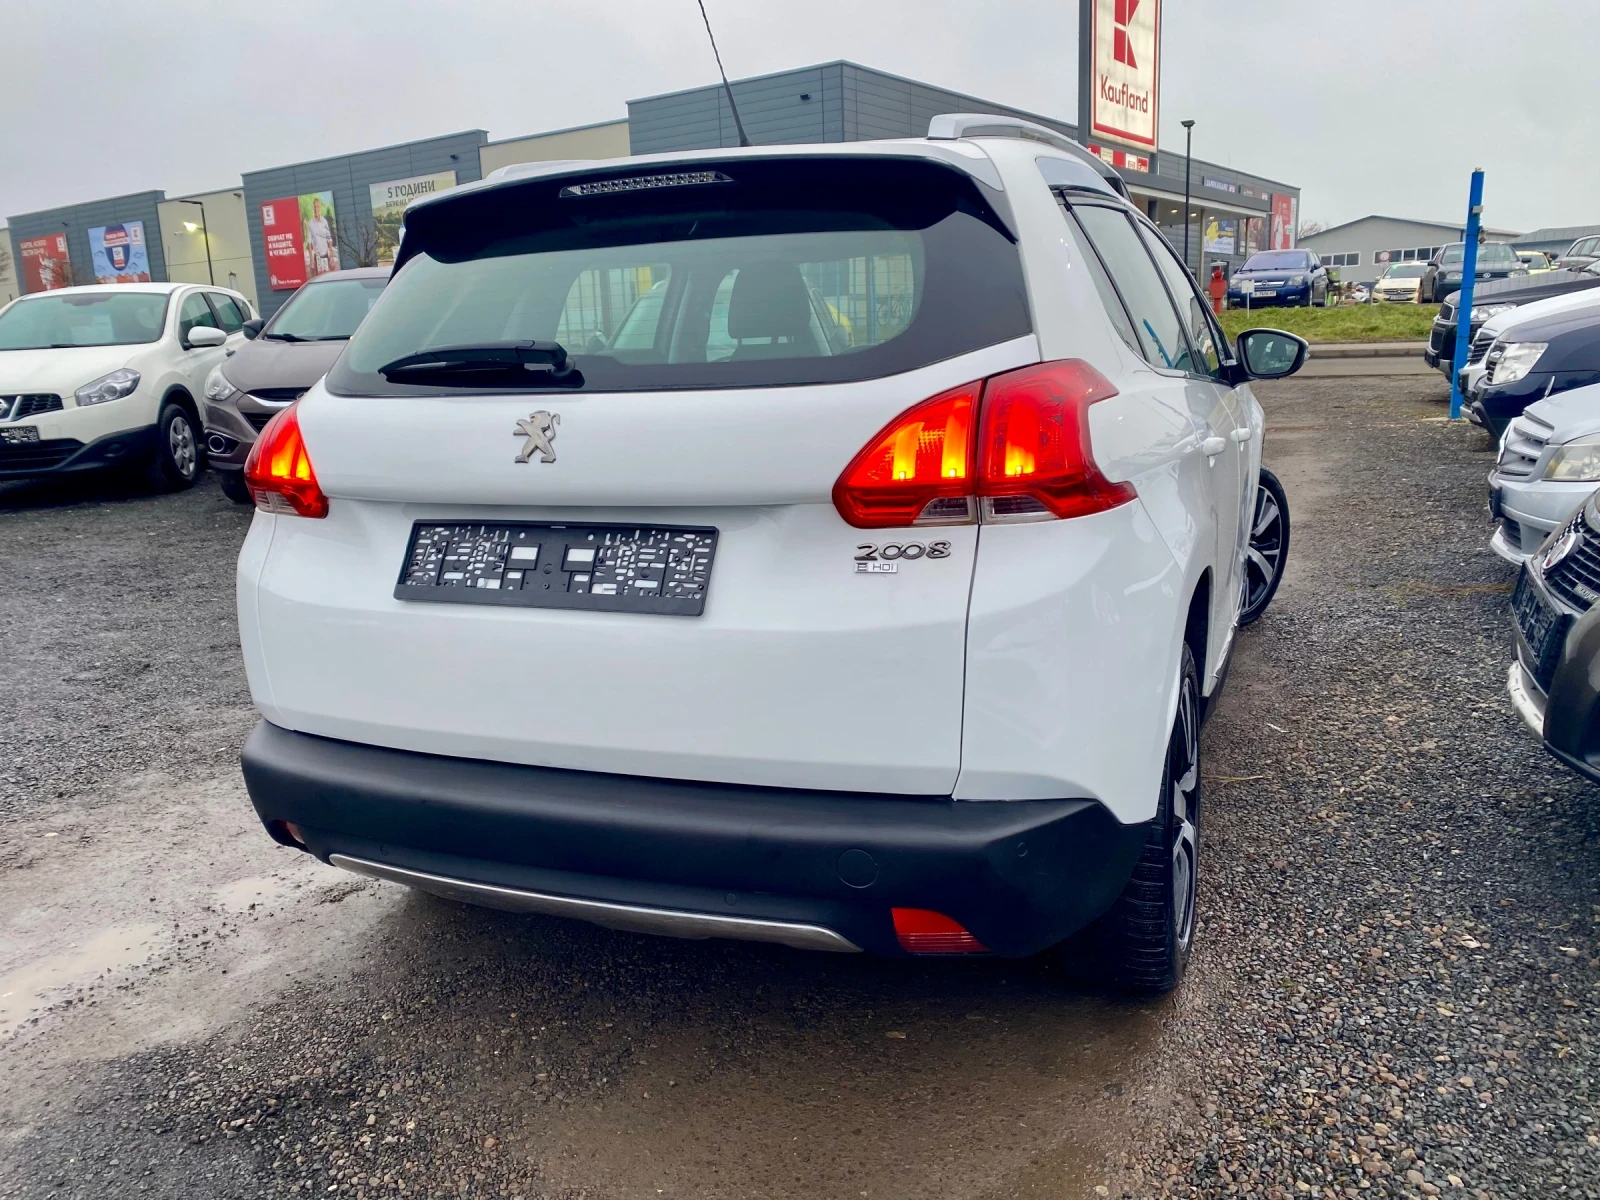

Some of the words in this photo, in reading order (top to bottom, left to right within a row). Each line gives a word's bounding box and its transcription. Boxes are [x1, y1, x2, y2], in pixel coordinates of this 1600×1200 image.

[1101, 74, 1148, 113] Kaufland
[388, 187, 393, 198] 5
[395, 180, 435, 197] ГОДИНИ
[854, 540, 952, 561] 2008
